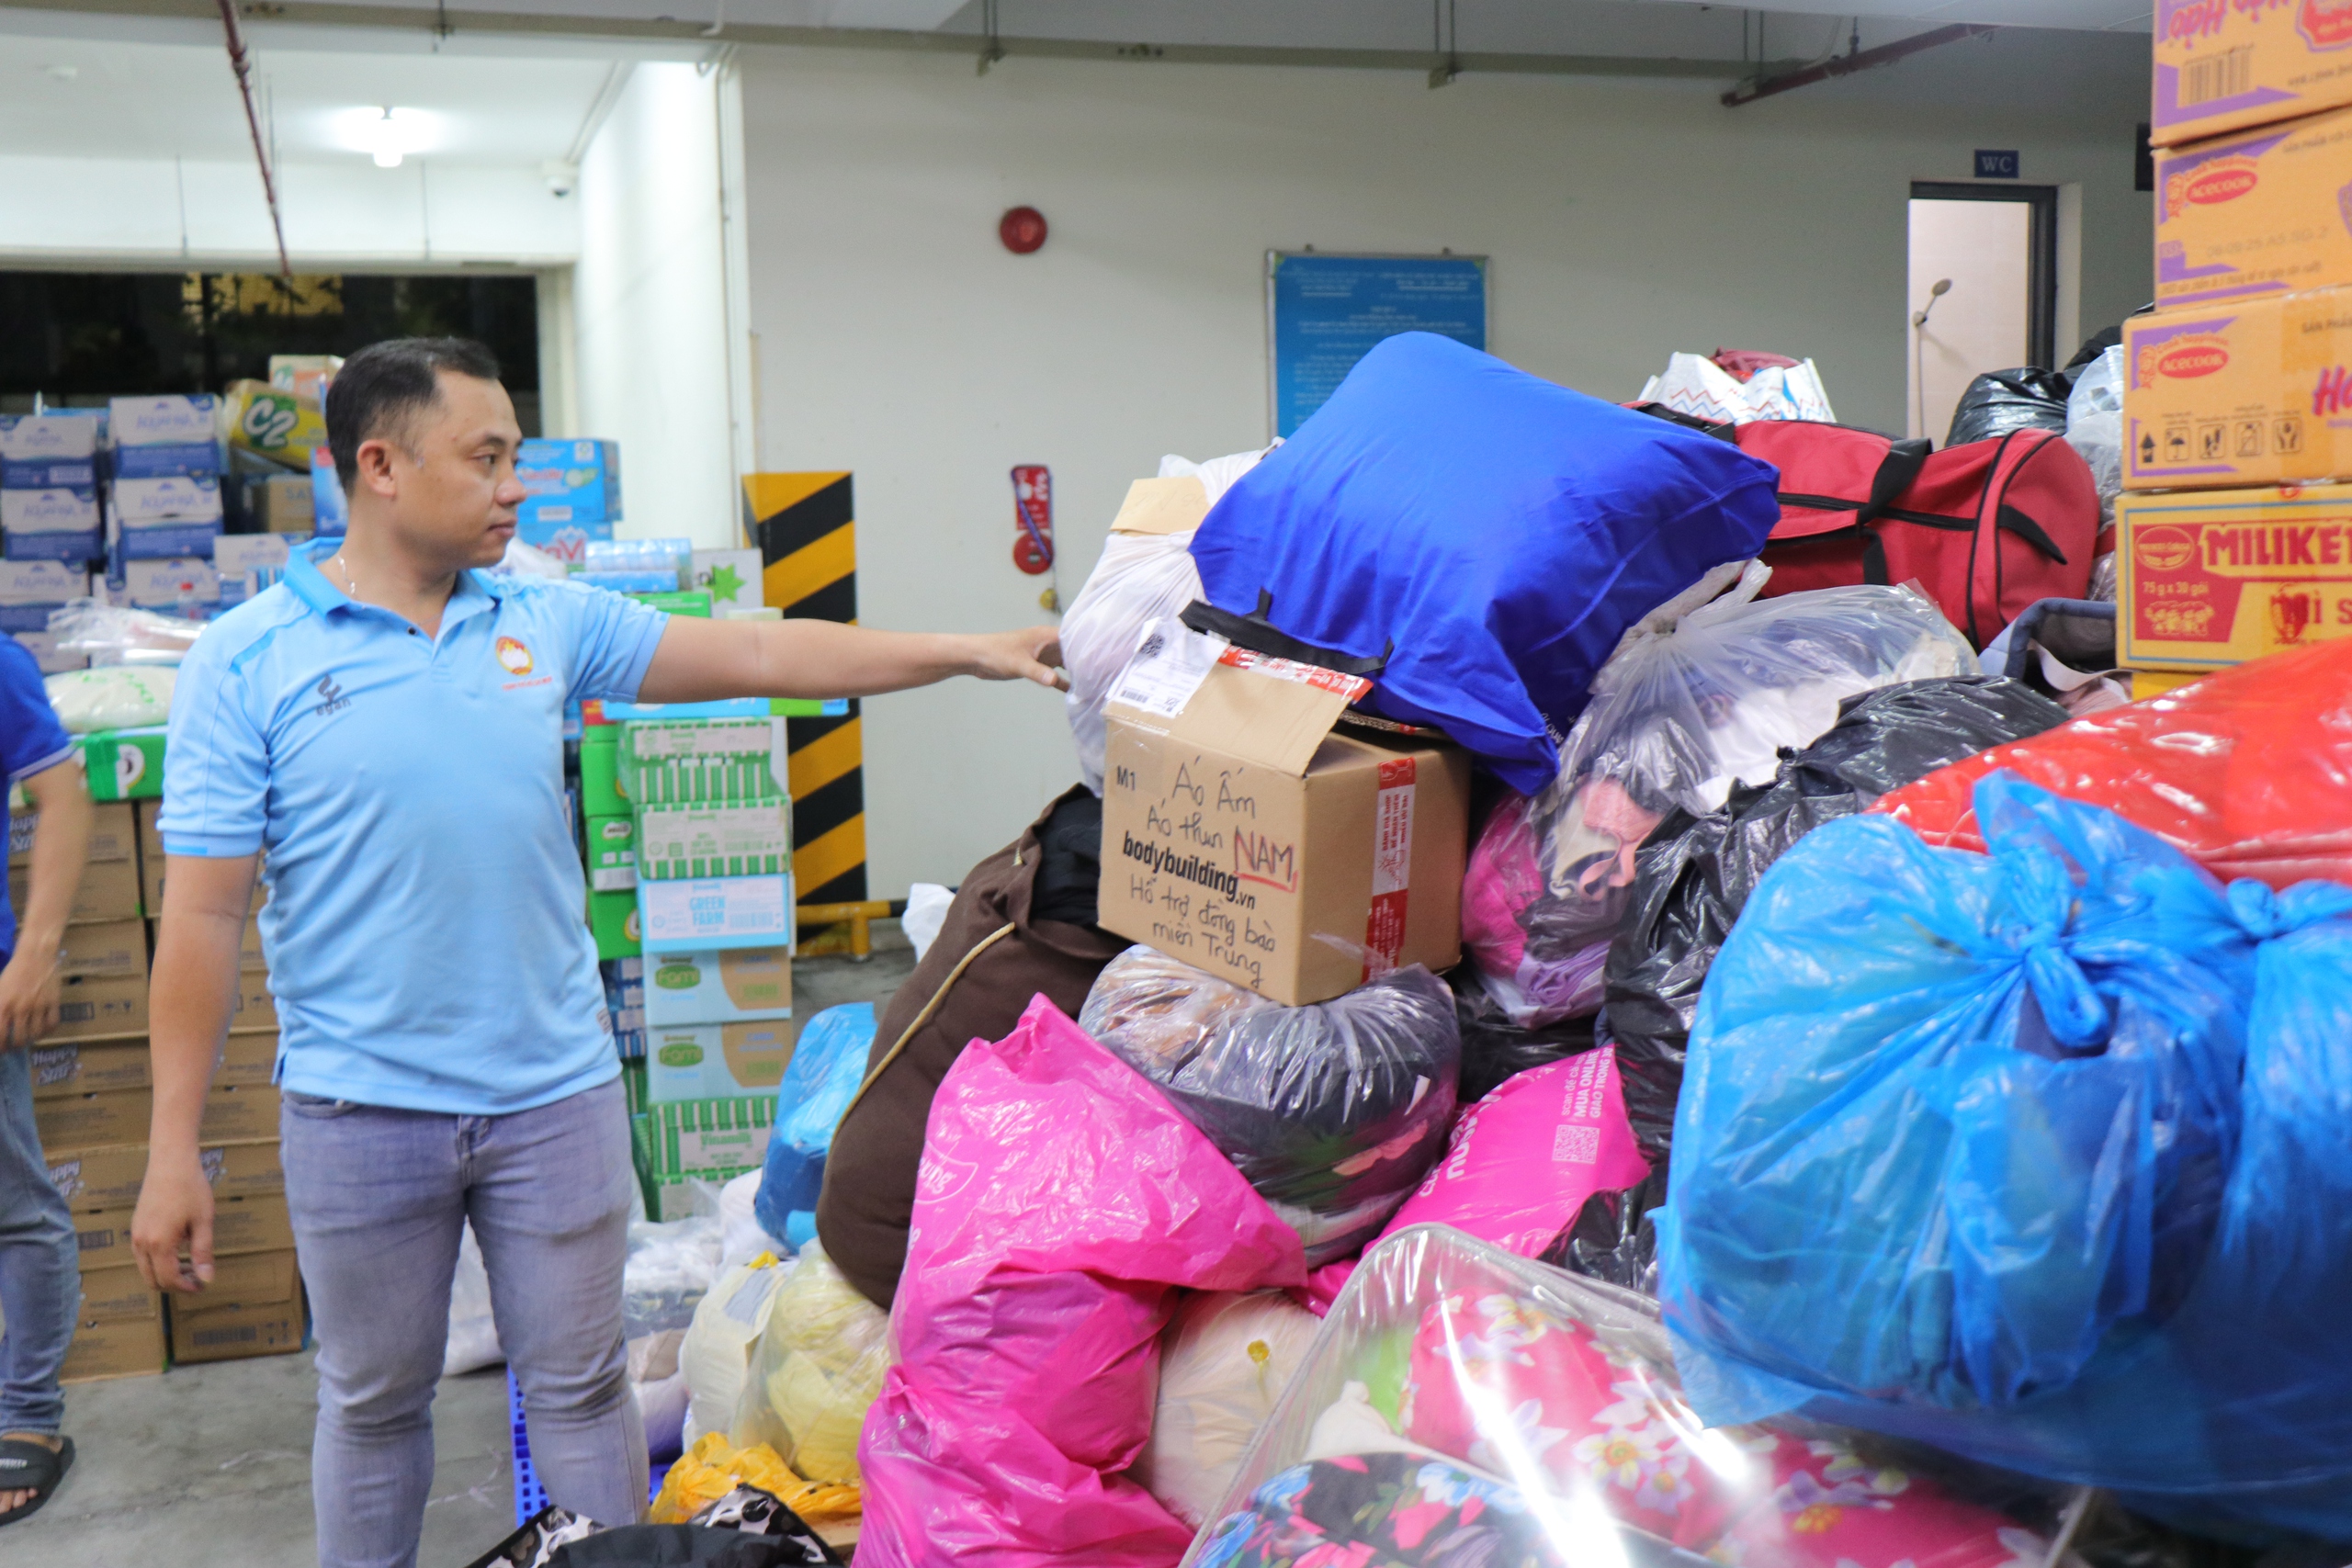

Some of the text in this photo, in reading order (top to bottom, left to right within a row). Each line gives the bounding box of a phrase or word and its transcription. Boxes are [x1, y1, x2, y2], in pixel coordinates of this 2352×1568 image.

[1981, 155, 2012, 173] WC
[243, 398, 299, 448] C2
[2143, 581, 2155, 594] 75
[2176, 581, 2188, 594] 30
[1117, 765, 1136, 791] M1
[1171, 754, 1256, 819] Áo Ấm
[1148, 797, 1295, 883] Áo thun NAM
[1123, 829, 1256, 910] bodybuilding.vn
[1244, 916, 1276, 953] bào
[1202, 931, 1265, 989] Trung
[1564, 1078, 1577, 1092] để
[1573, 1050, 1600, 1118] MUA ONLINE
[1593, 1058, 1611, 1090] TRONG
[1561, 1092, 1574, 1117] scan
[1589, 1090, 1604, 1118] GIAO
